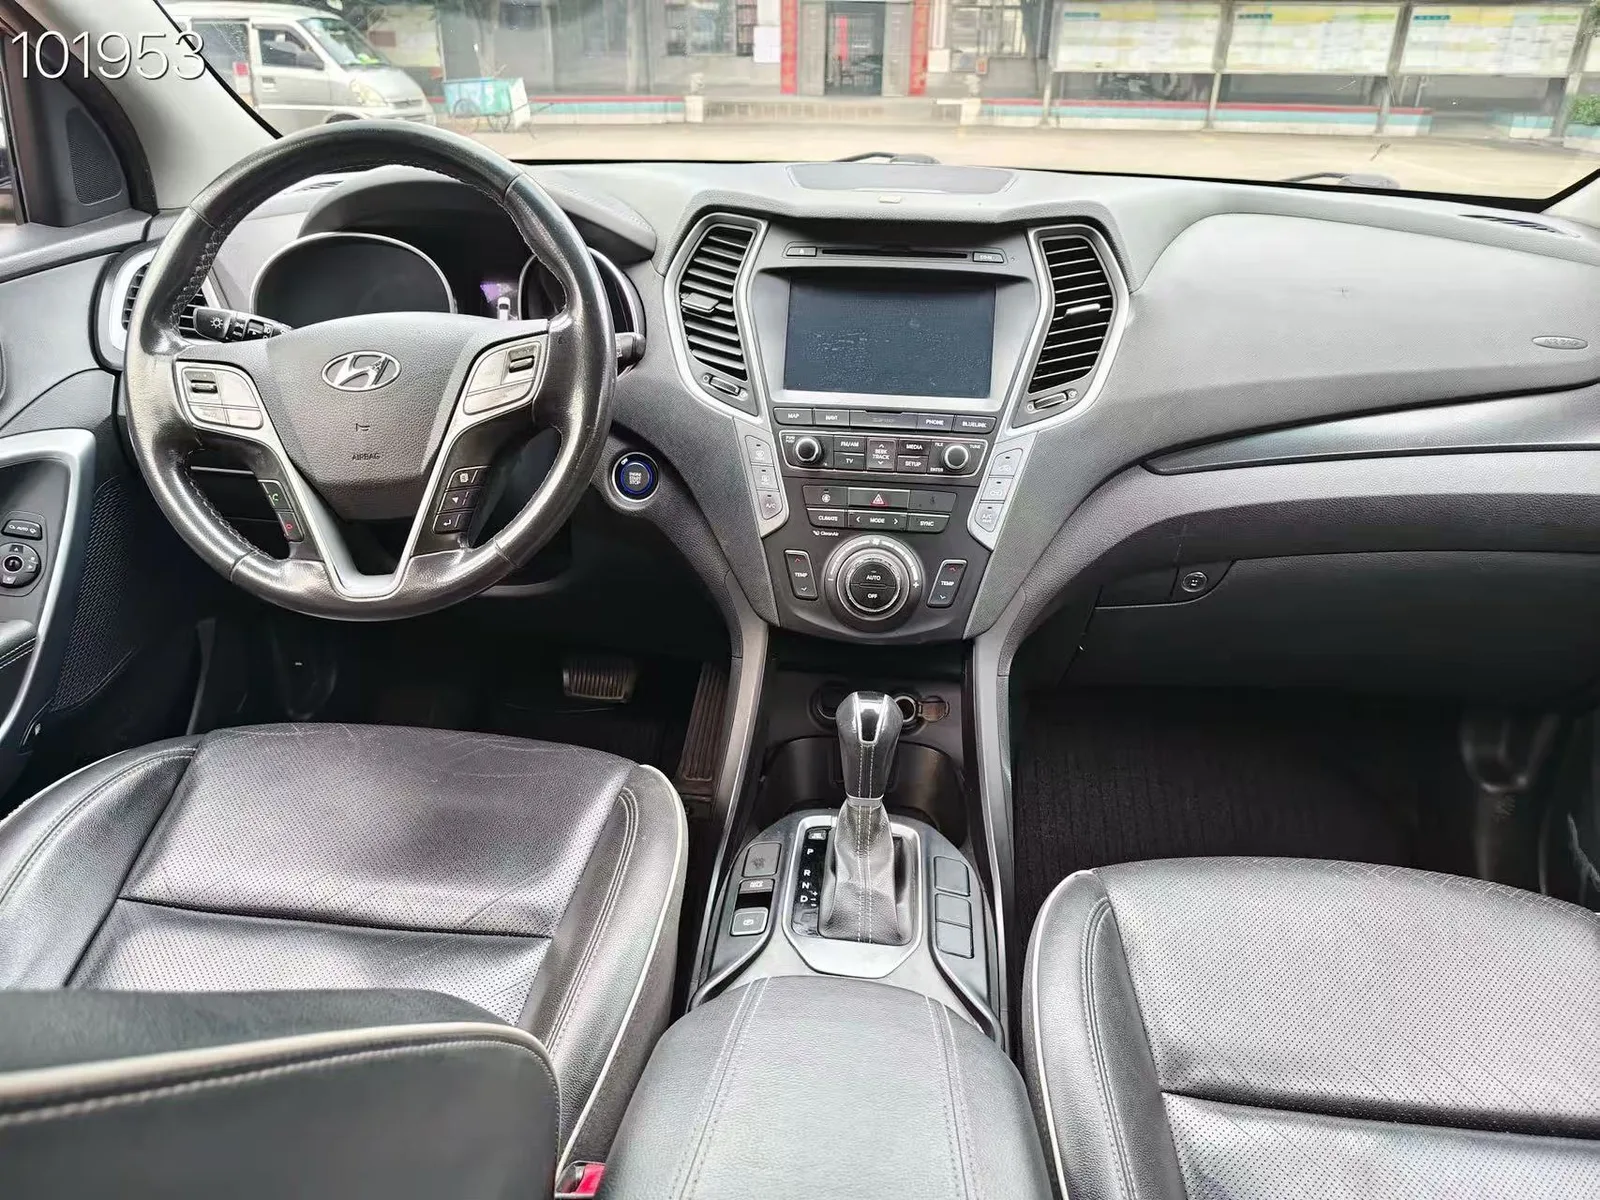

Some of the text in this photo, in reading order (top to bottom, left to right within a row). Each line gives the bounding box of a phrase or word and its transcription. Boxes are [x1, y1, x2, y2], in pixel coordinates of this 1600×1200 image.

[351, 452, 381, 461] AIRBAG
[803, 869, 811, 877] R
[800, 895, 809, 903] D
